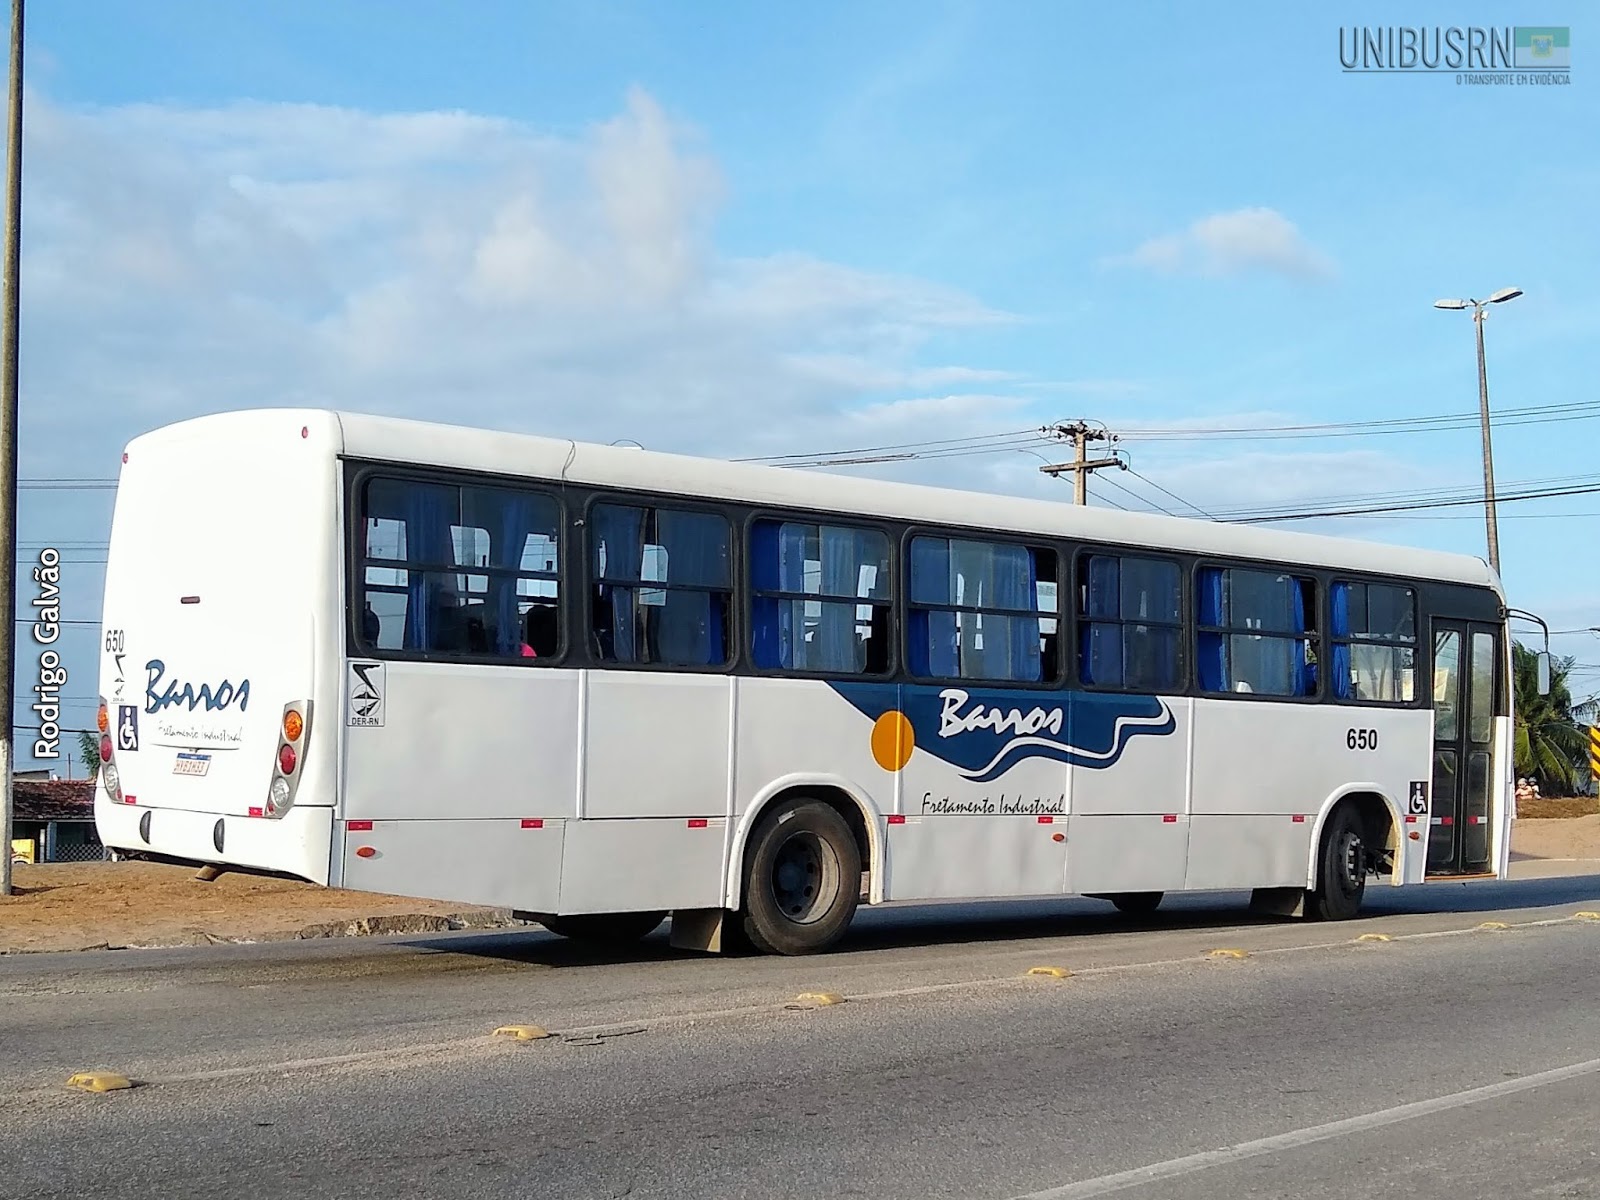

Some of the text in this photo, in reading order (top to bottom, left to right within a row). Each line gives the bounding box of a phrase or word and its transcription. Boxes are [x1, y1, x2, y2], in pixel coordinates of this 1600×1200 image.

[105, 629, 125, 653] 650
[145, 659, 250, 714] Barros
[351, 717, 380, 725] DER-RN
[938, 689, 1063, 738] Barros
[1346, 728, 1378, 750] 650
[921, 792, 1064, 815] Fretamento Industrial
